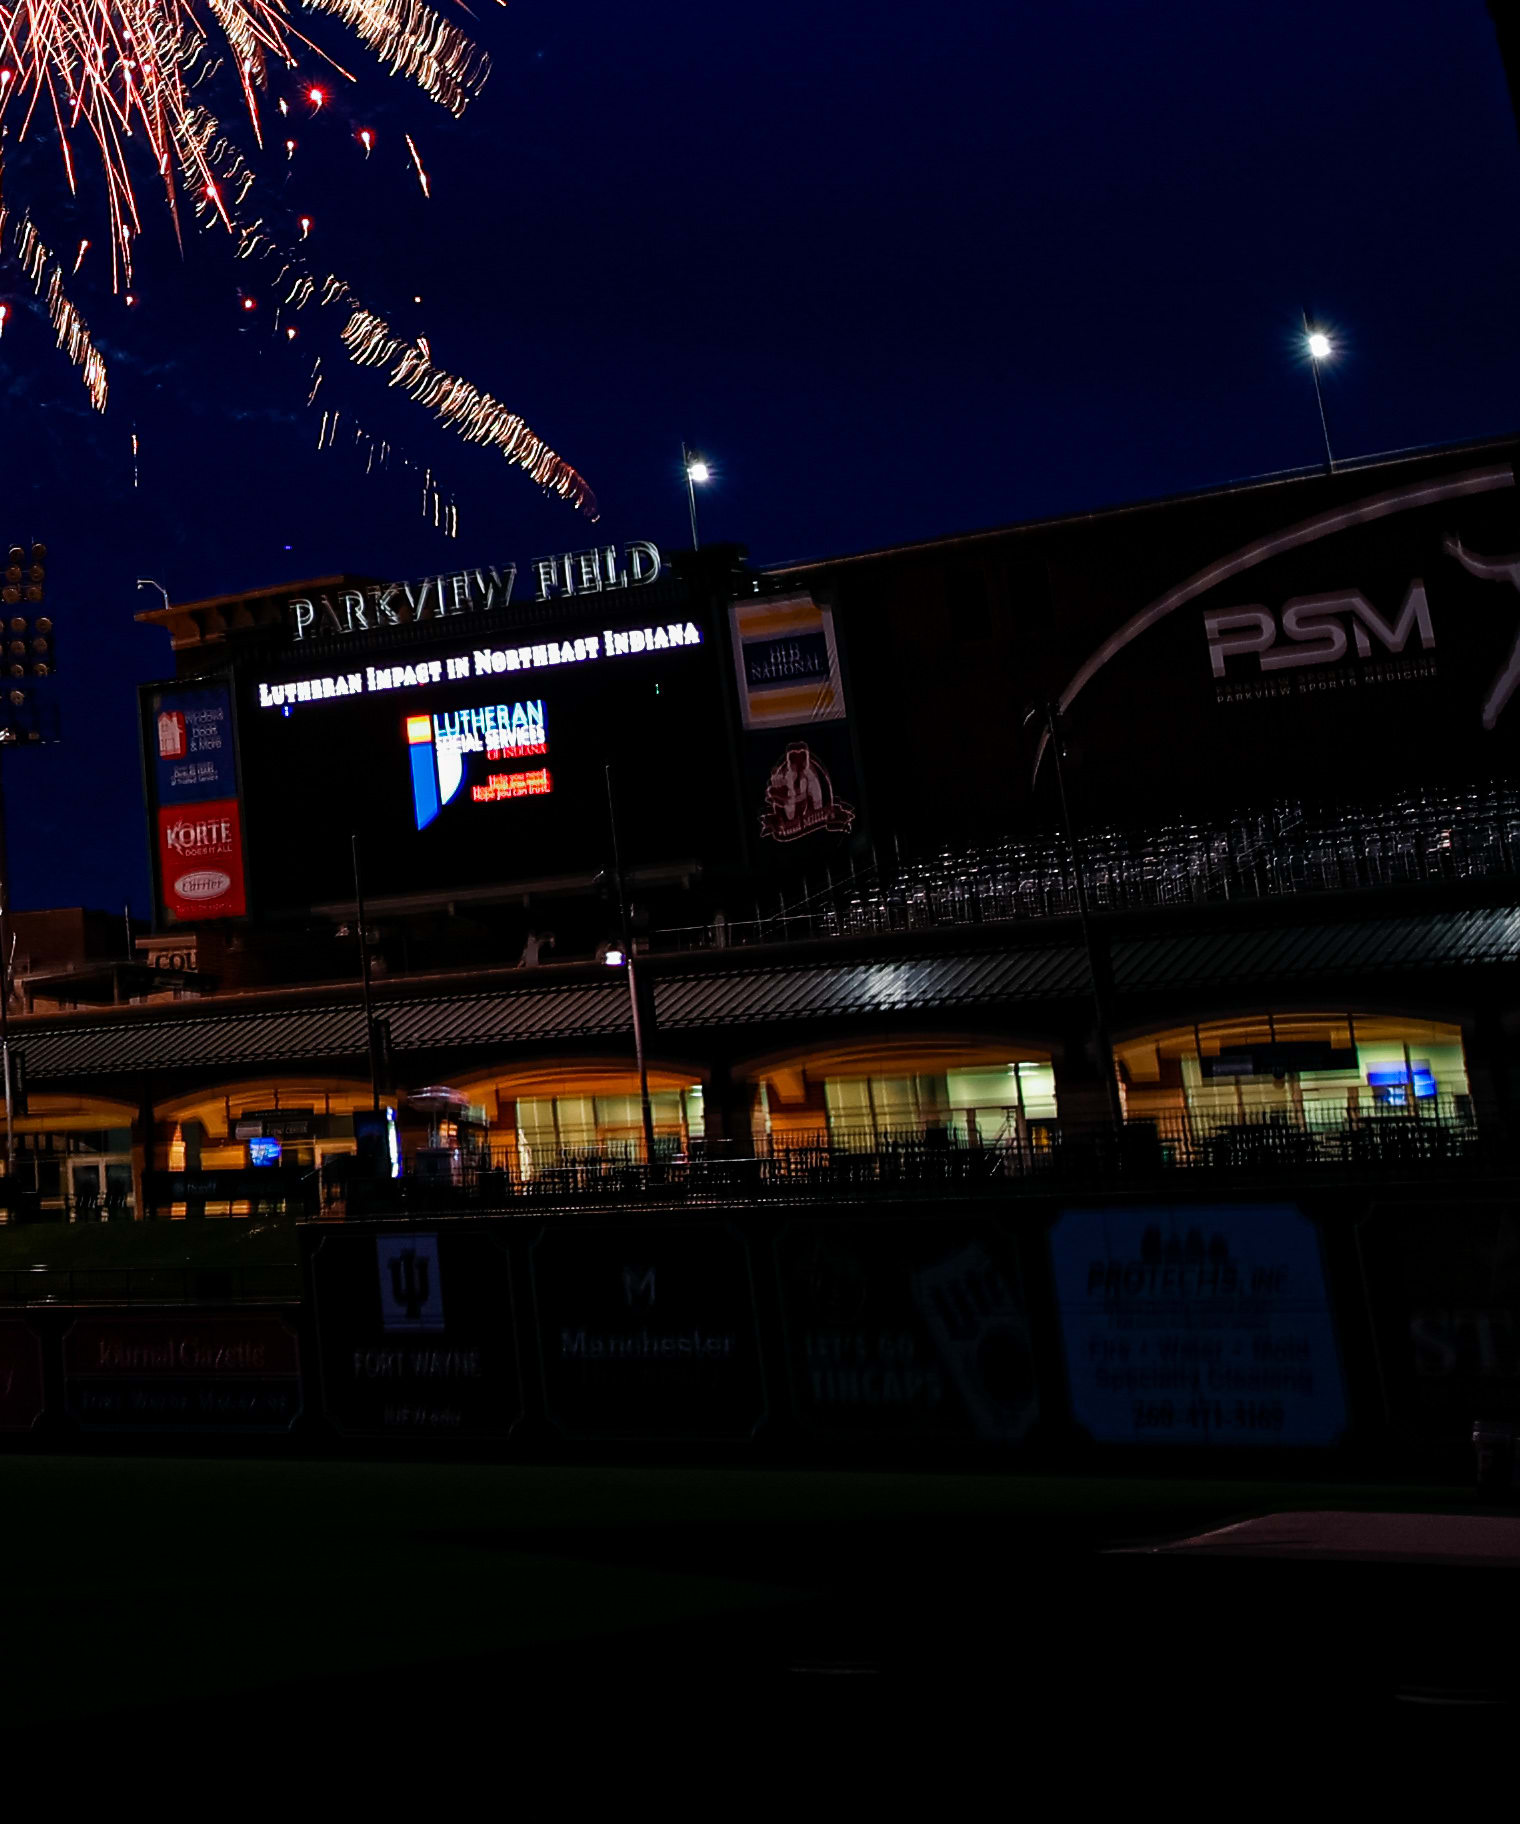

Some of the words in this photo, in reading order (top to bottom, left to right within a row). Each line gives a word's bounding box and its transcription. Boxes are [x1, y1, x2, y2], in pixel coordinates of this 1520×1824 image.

[290, 563, 517, 641] PARKVIEW
[531, 540, 662, 602] FIELD
[1203, 576, 1437, 678] PSM
[751, 652, 825, 680] NATIONAL
[1216, 684, 1290, 704] PARKVIEW
[1299, 674, 1358, 694] SPORTS
[1364, 663, 1439, 683] MEDICINE
[433, 699, 544, 736] LUTHERAN
[166, 817, 233, 855] KORTE
[217, 843, 233, 854] ALL
[182, 878, 224, 893] Carrier
[559, 1324, 737, 1360] Manchester
